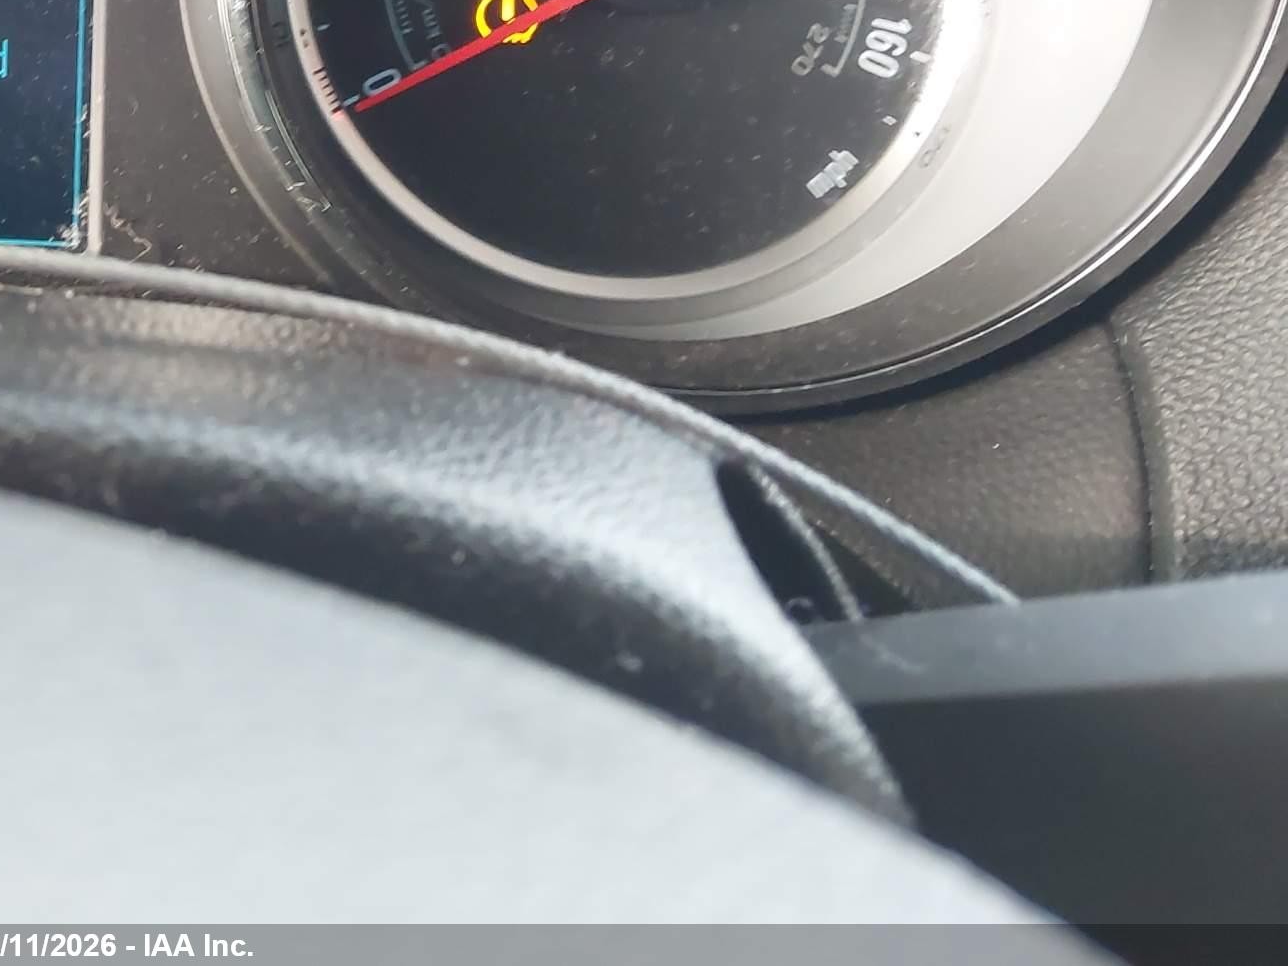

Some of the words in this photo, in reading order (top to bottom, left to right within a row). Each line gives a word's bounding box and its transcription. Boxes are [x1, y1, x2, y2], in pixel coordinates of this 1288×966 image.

[791, 23, 830, 76] 270
[858, 18, 913, 78] 160
[362, 68, 403, 96] 0
